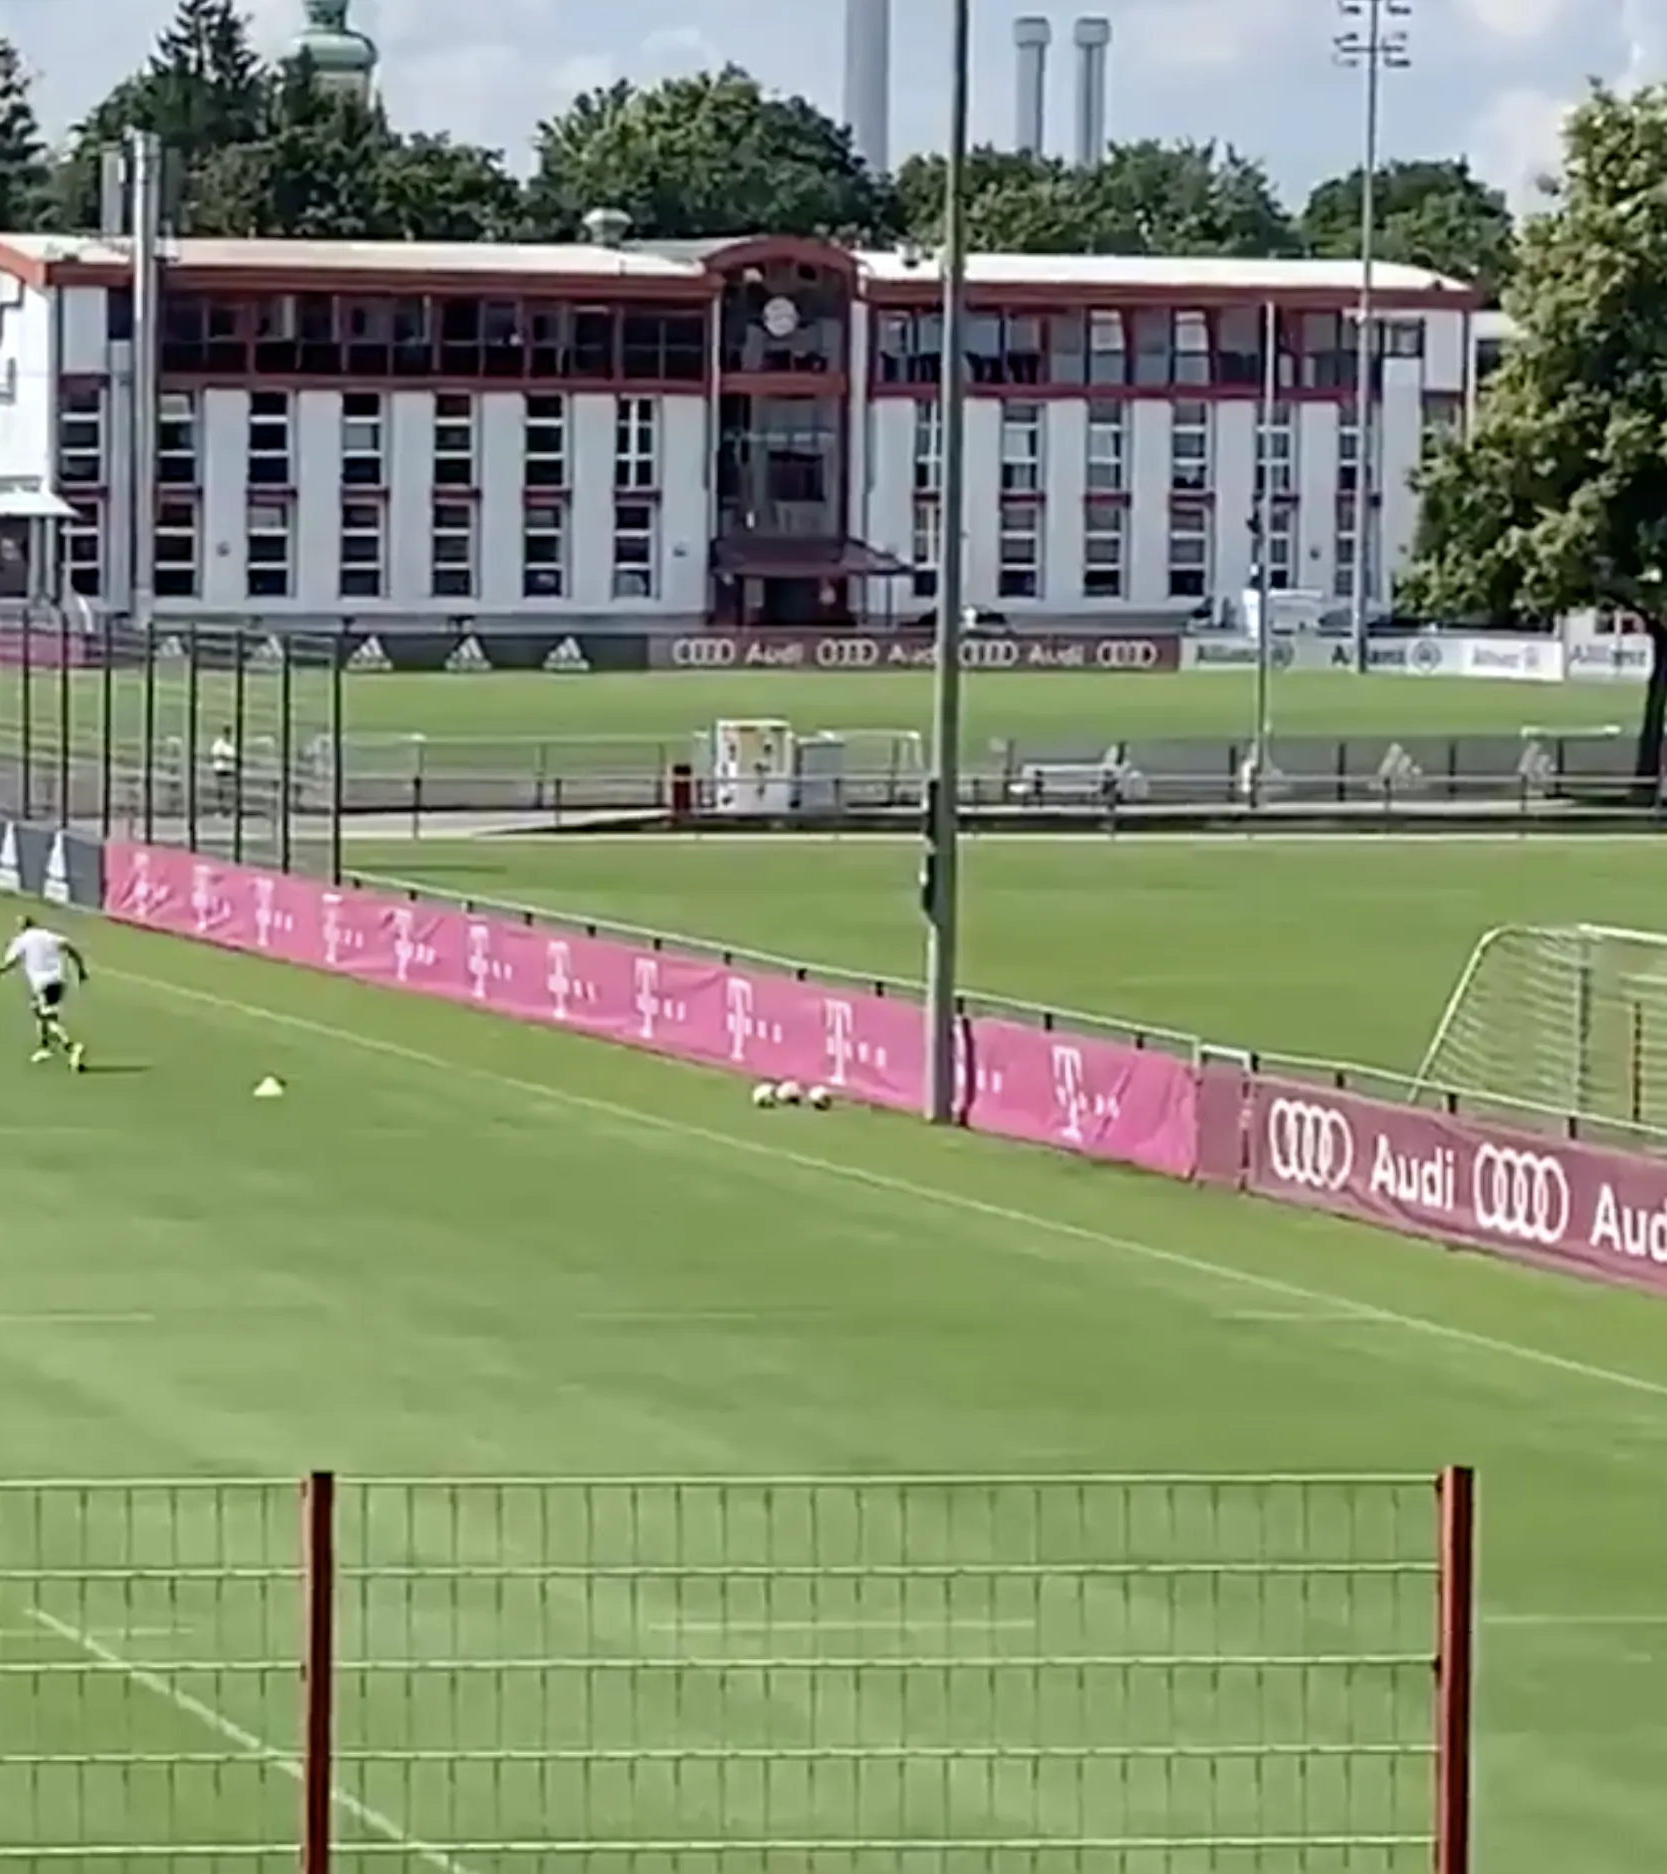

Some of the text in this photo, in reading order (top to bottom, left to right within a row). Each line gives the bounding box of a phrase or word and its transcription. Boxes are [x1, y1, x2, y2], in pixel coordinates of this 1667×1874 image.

[745, 640, 804, 665] Audi
[887, 641, 942, 665] Aud
[1028, 641, 1085, 665] Audi
[1370, 1134, 1455, 1212] Audi
[1589, 1183, 1667, 1263] Aud
